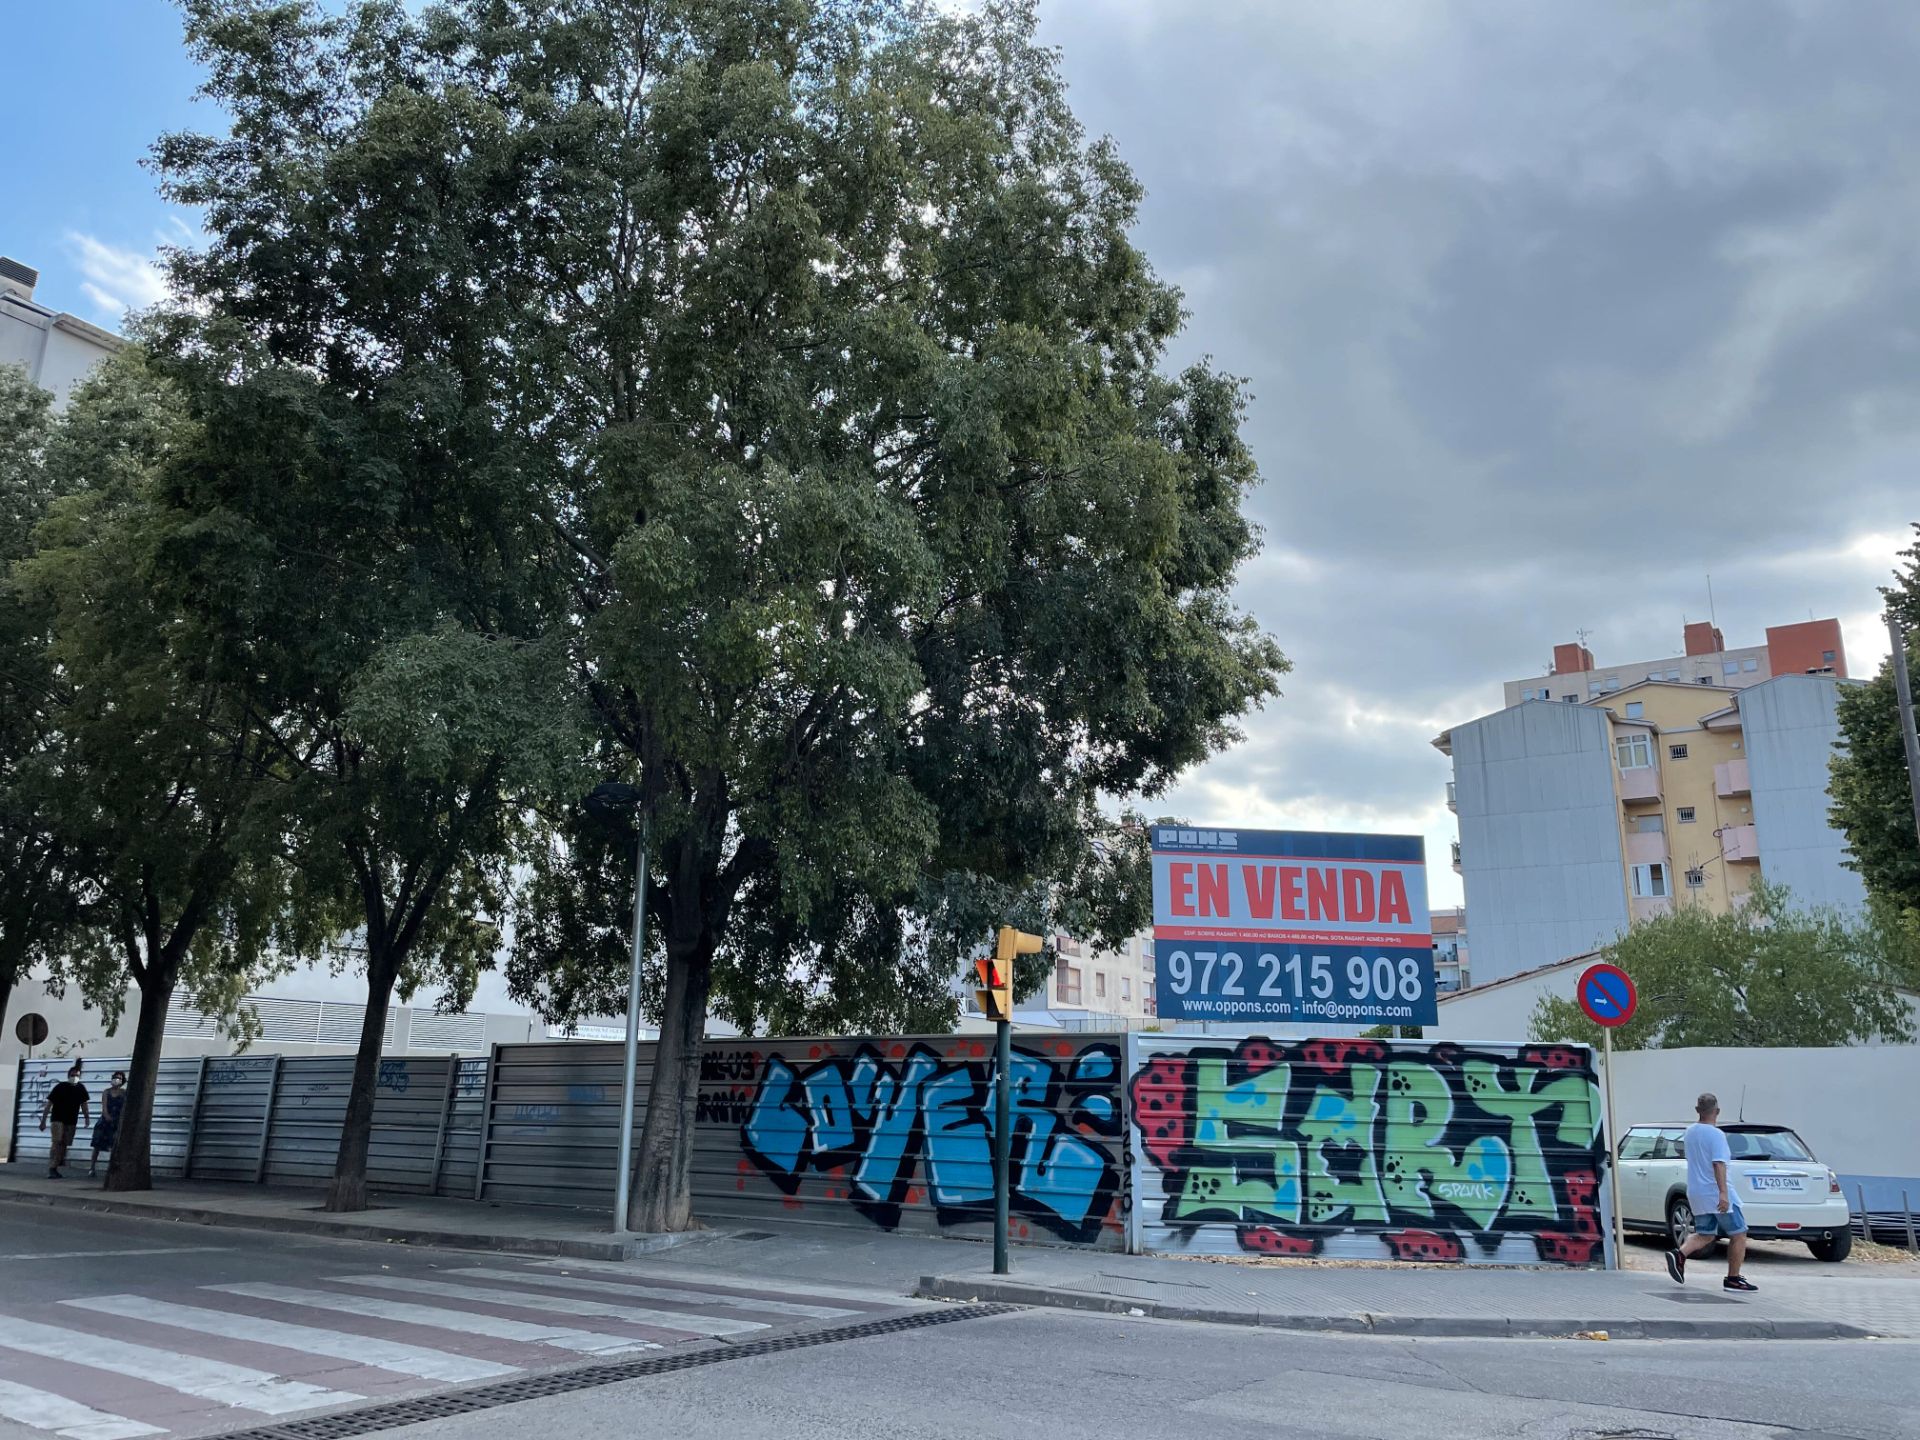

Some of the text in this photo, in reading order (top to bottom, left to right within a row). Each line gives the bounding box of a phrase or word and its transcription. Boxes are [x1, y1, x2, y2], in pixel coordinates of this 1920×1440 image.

[1158, 830, 1238, 846] PONS
[1169, 862, 1412, 925] EN VENDA
[1168, 950, 1422, 1001] 972 215 908
[1182, 1000, 1291, 1015] www.oppons.com
[1302, 1000, 1412, 1018] info@oppons.com
[1758, 1177, 1781, 1187] 7420
